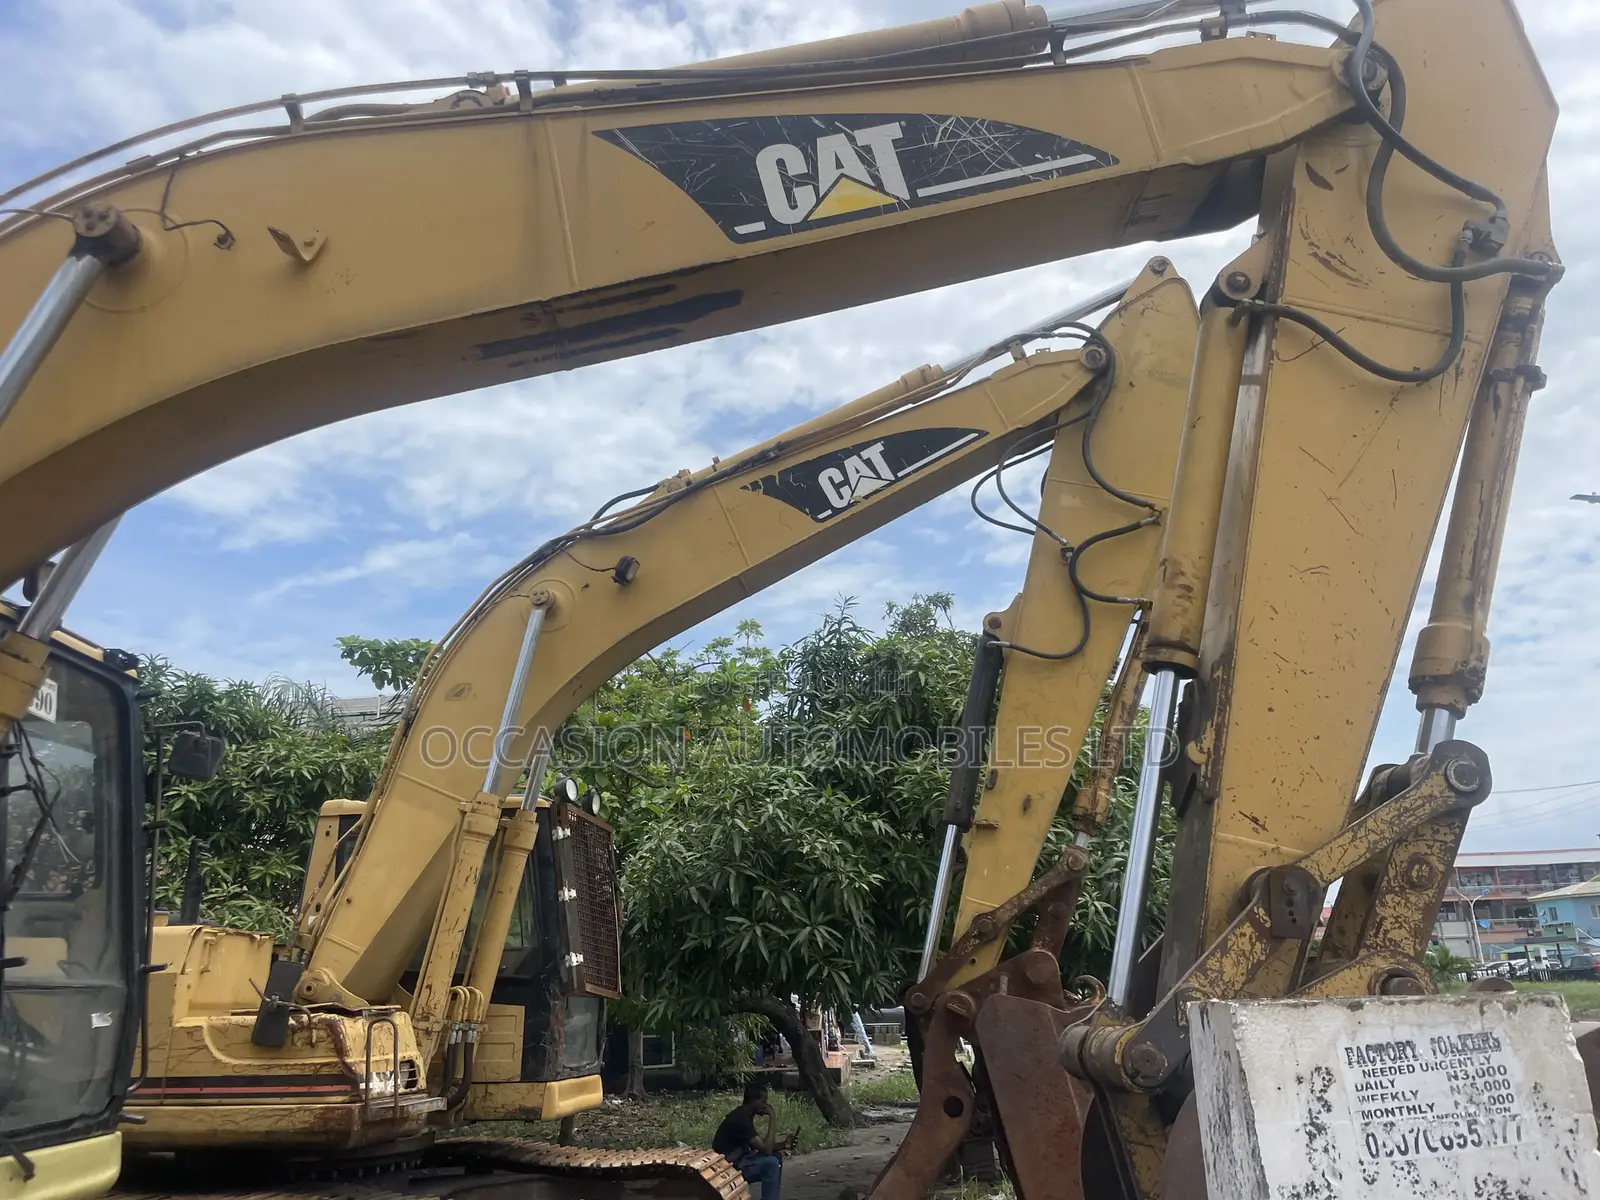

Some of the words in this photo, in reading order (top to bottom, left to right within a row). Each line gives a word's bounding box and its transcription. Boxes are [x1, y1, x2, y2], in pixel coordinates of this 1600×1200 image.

[756, 121, 910, 224] CAT
[817, 441, 895, 509] CAT
[1362, 1063, 1416, 1079] NEEDED
[1354, 1078, 1396, 1092] DAILY
[1357, 1089, 1419, 1106] WEEKLY
[1361, 1102, 1435, 1122] MONTHLY
